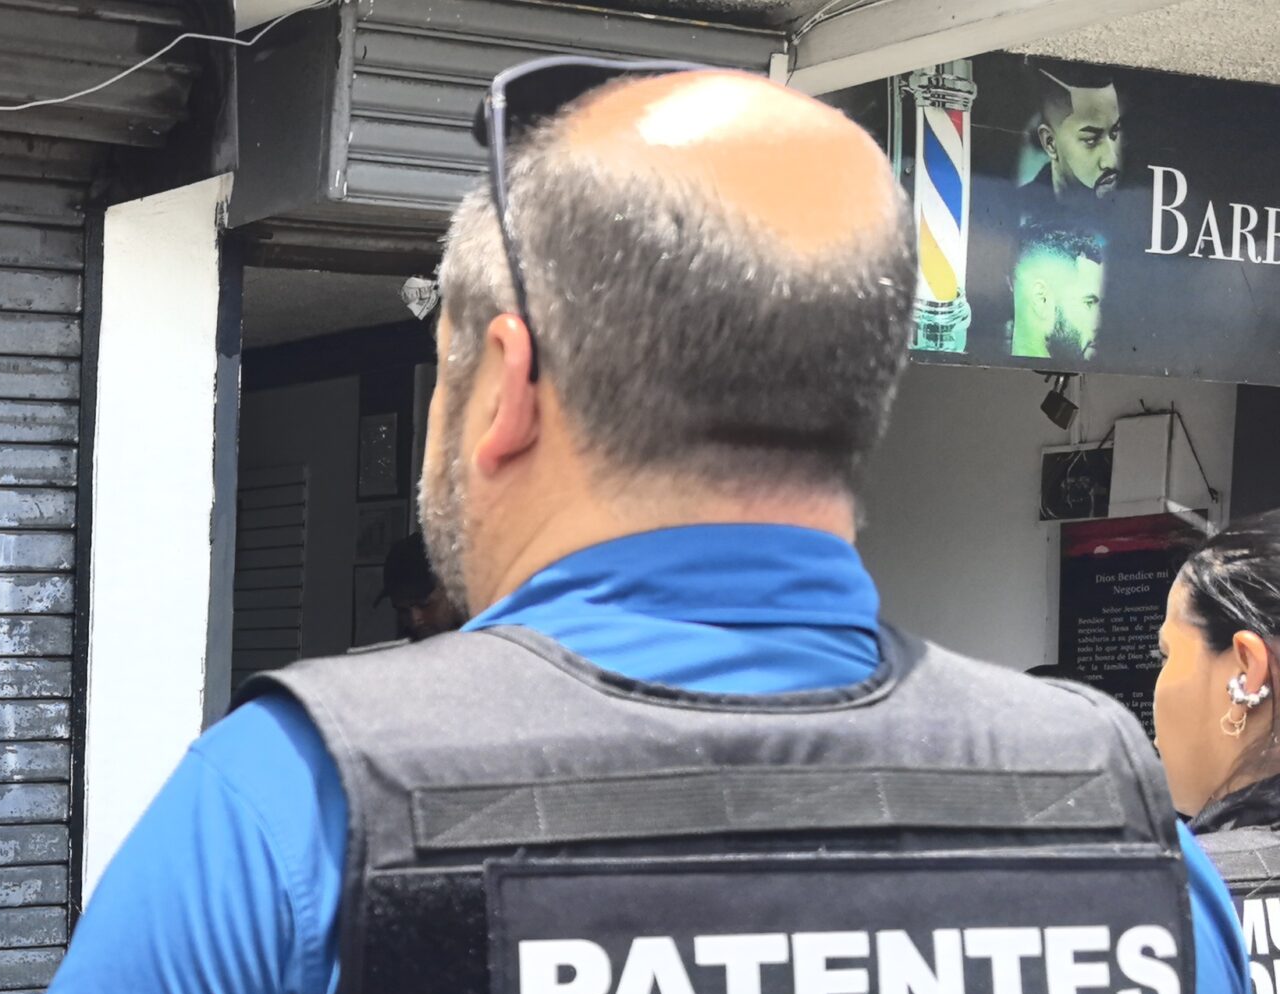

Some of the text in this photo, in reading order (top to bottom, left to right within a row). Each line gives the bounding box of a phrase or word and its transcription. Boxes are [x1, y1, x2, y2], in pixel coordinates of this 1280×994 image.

[1095, 573, 1116, 584] Dios
[1117, 570, 1154, 582] Bendice
[1113, 584, 1150, 596] Negocio
